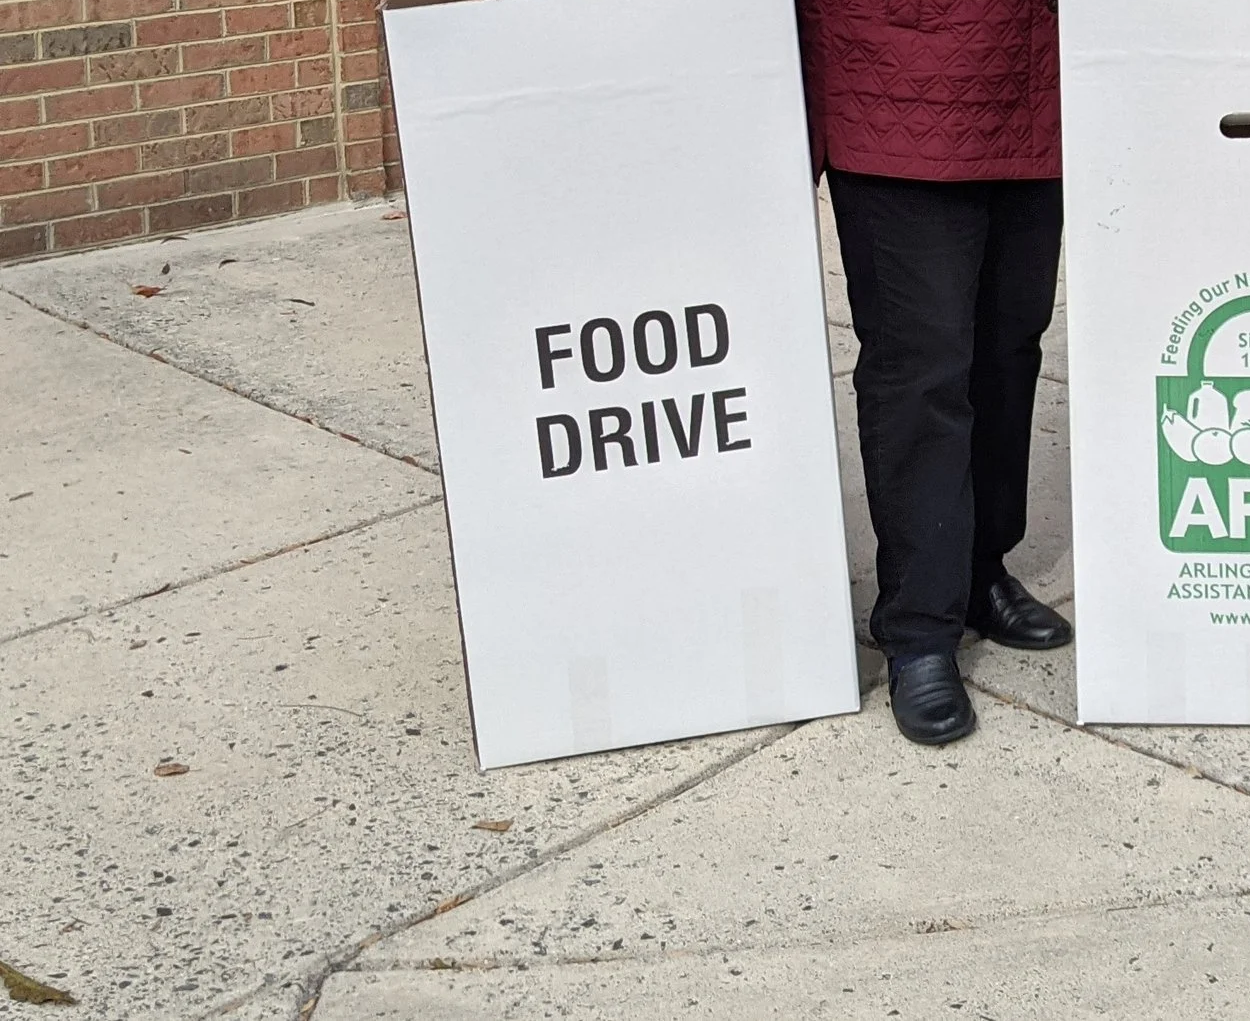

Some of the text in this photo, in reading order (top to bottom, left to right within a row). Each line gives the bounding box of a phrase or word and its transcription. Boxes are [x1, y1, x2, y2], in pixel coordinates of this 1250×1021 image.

[535, 303, 730, 390] FOOD
[1161, 300, 1203, 365] Feeding
[1199, 278, 1231, 305] Our
[535, 387, 752, 479] DRIVE
